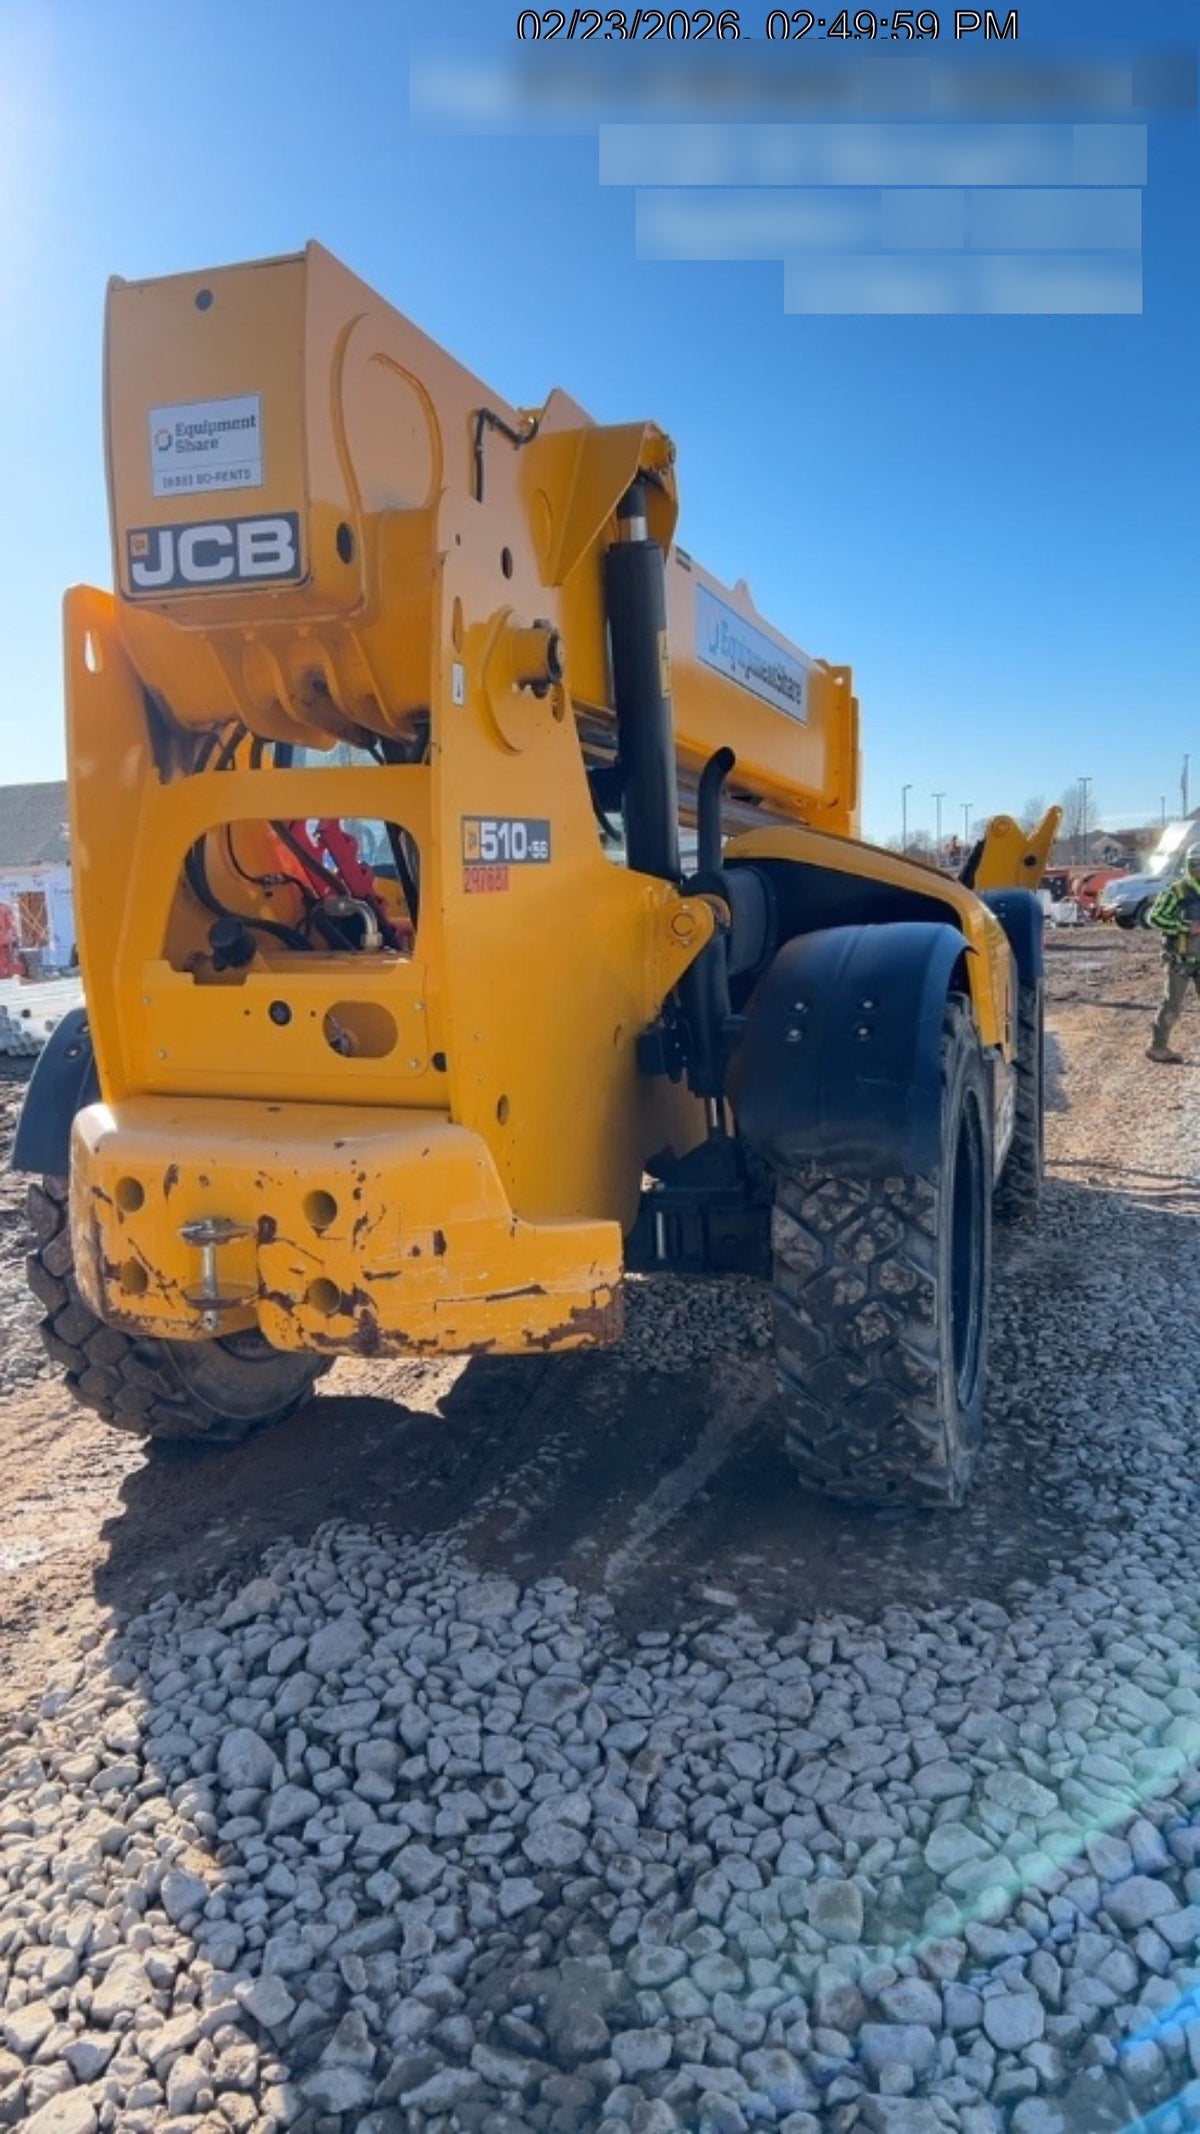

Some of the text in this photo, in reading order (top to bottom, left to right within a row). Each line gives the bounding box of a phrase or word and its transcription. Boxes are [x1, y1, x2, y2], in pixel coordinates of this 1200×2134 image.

[174, 414, 256, 438] Equipment
[174, 438, 219, 453] Share
[132, 519, 295, 586] JCB
